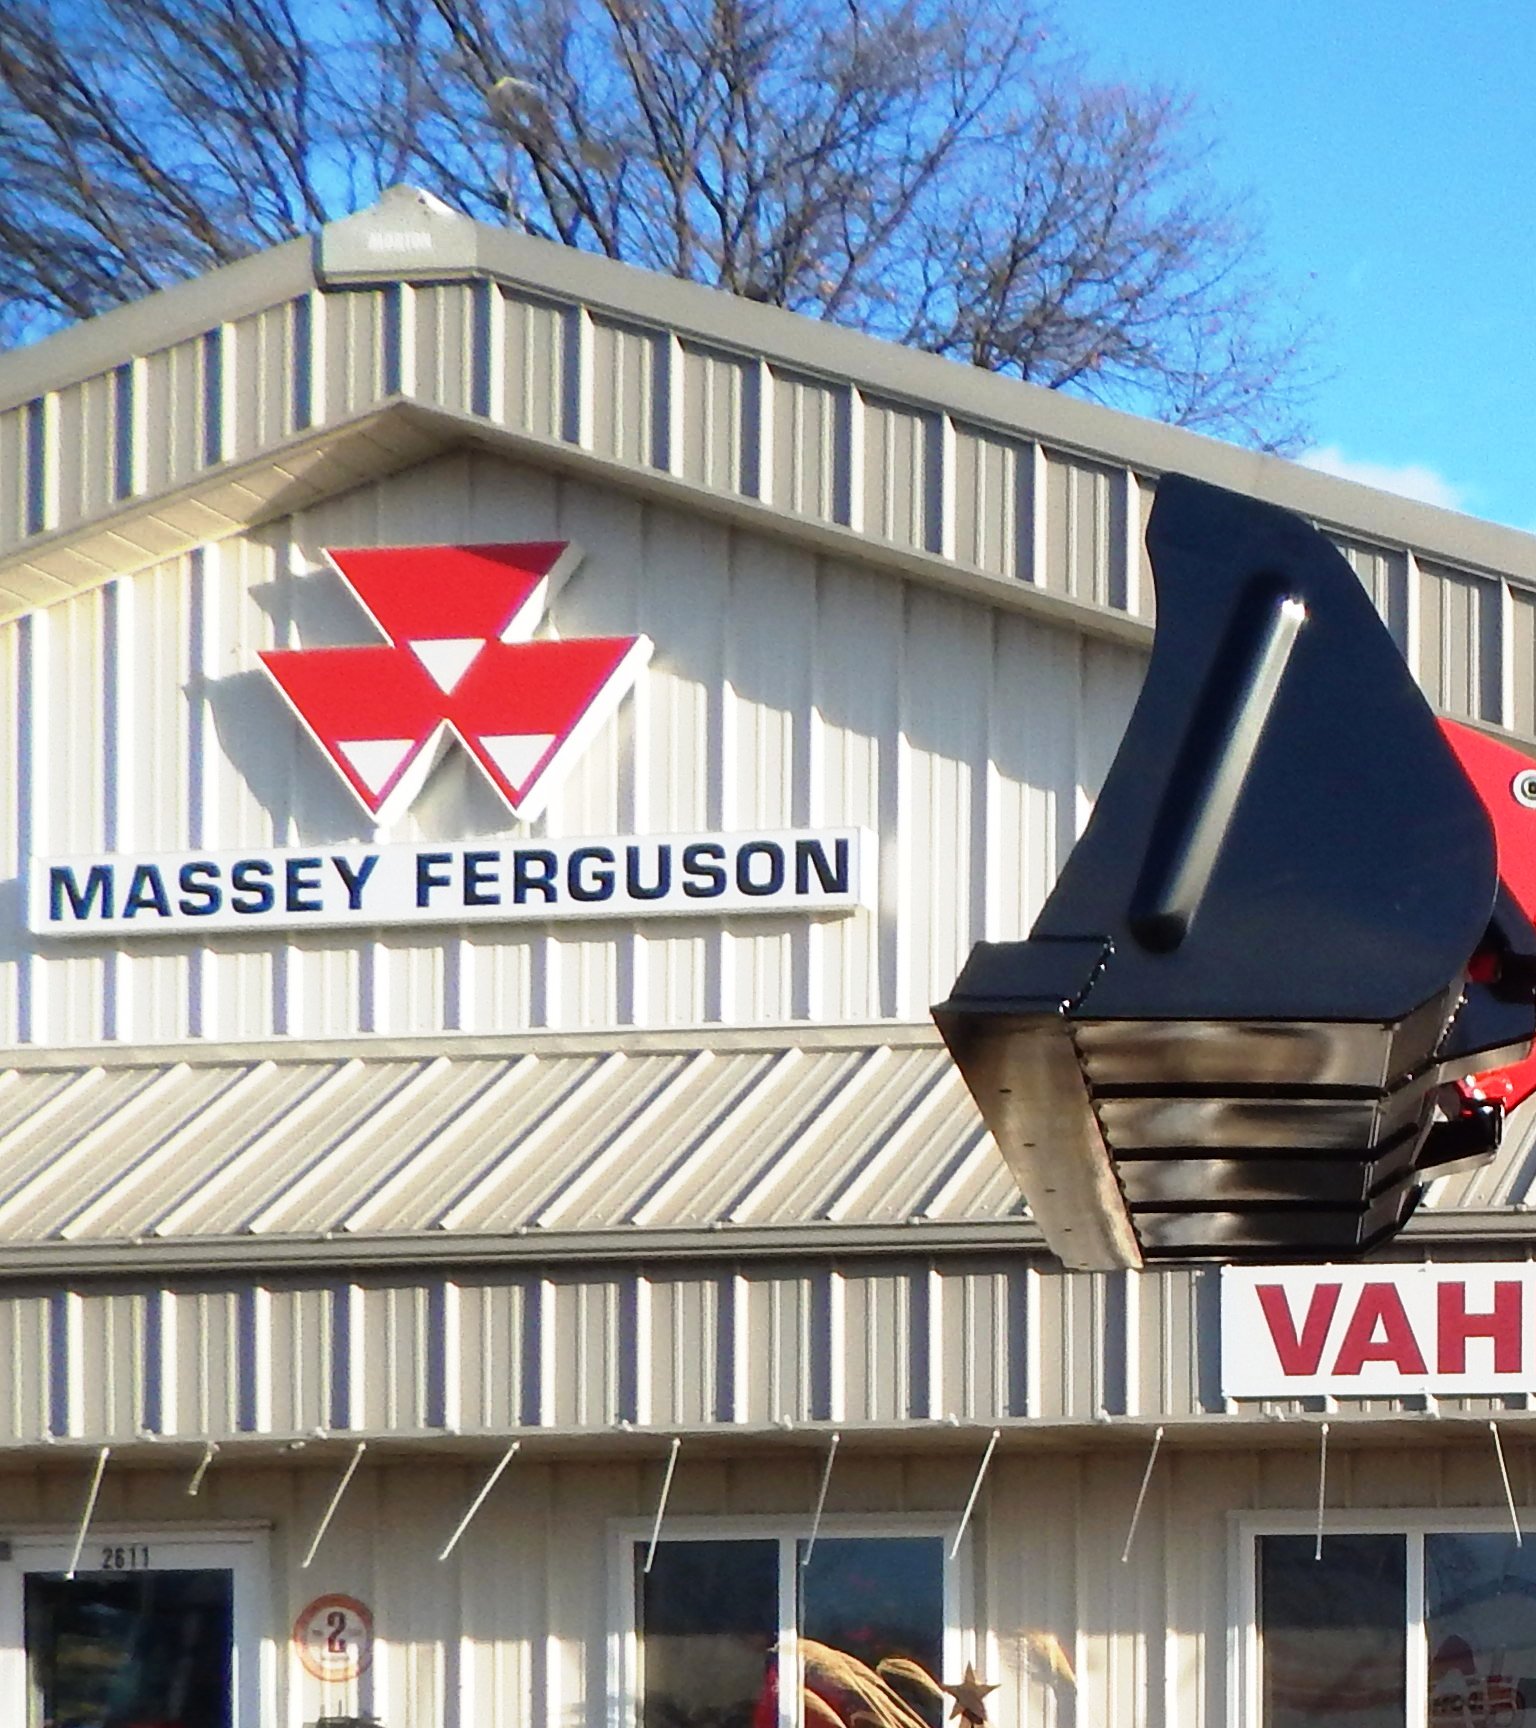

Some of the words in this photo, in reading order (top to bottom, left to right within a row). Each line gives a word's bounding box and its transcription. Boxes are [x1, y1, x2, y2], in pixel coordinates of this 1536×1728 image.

[48, 854, 381, 922] MASSEY
[414, 837, 852, 909] FERGUSON
[101, 1546, 149, 1569] 2611
[327, 1611, 347, 1653] 2
